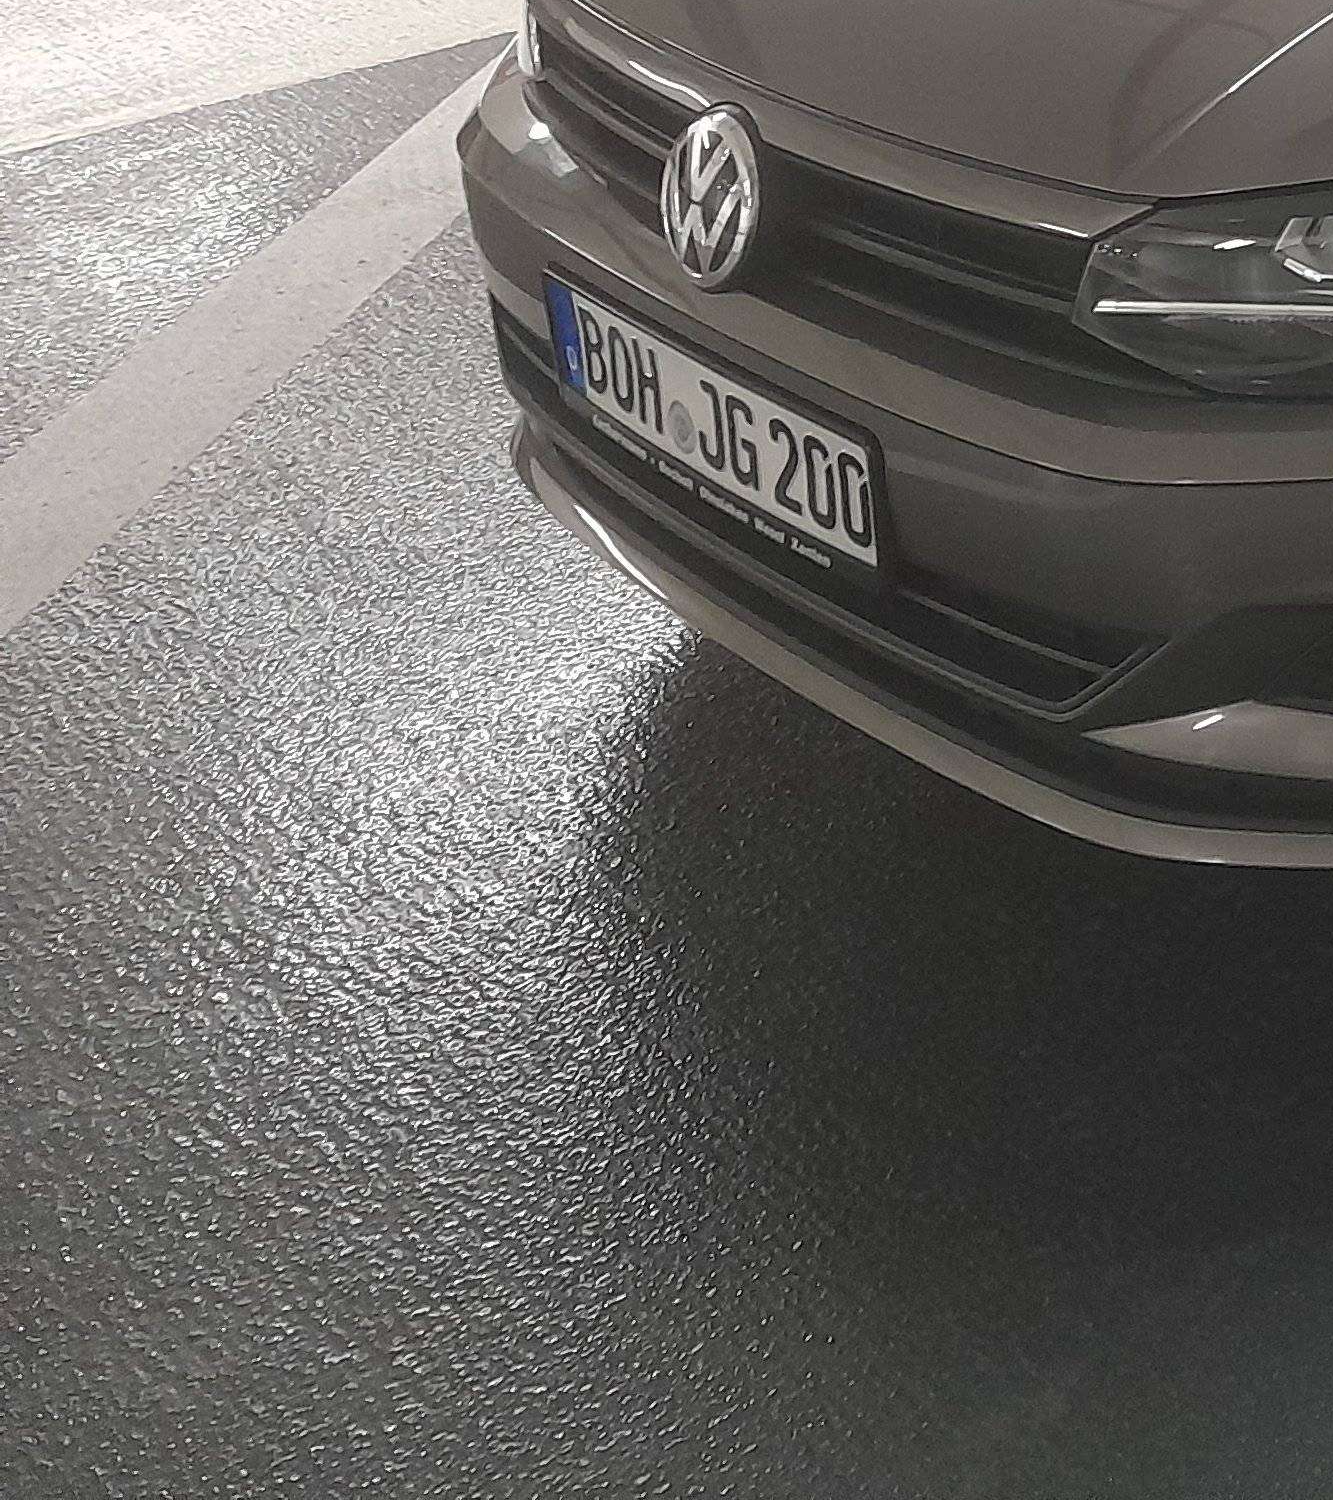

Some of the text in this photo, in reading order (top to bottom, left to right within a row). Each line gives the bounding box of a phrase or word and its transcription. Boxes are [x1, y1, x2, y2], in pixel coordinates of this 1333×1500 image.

[662, 108, 758, 286] VW
[577, 304, 664, 435] BOH
[698, 379, 760, 492] JG
[768, 417, 873, 548] 200
